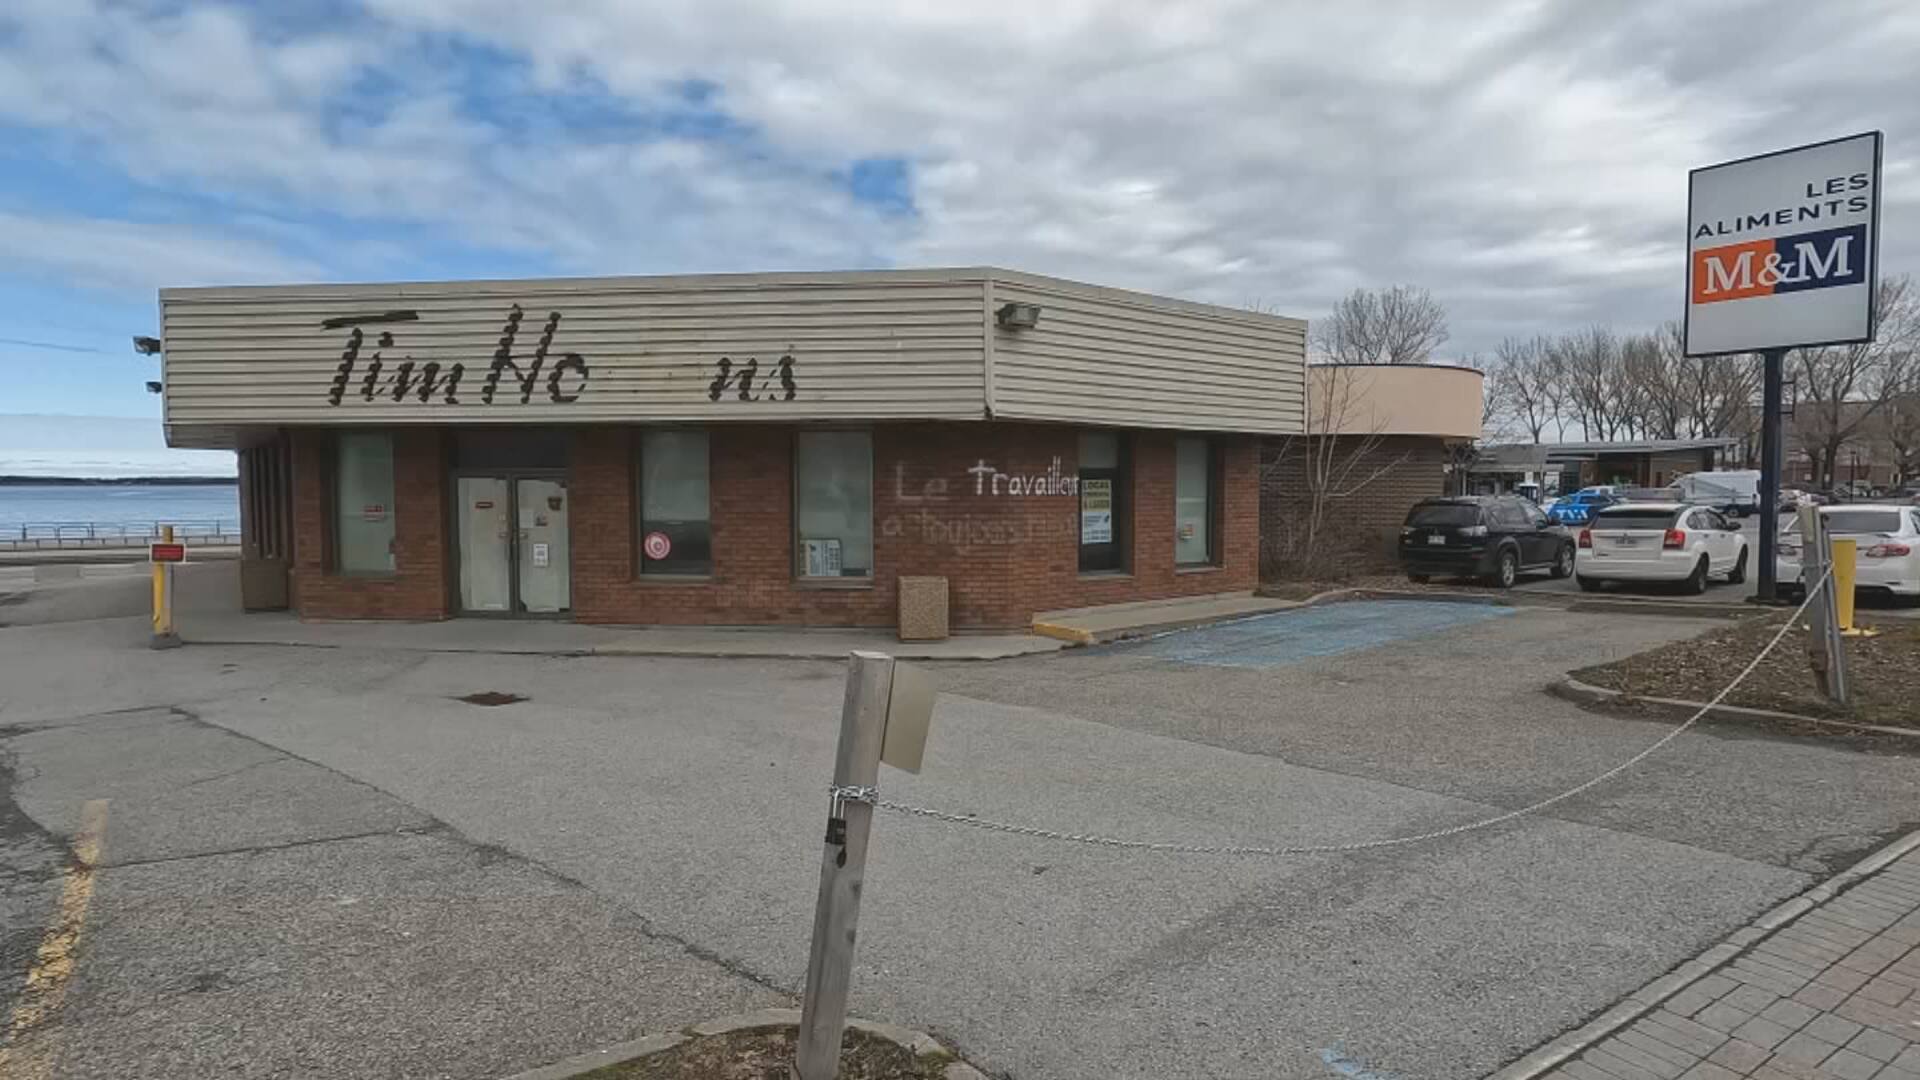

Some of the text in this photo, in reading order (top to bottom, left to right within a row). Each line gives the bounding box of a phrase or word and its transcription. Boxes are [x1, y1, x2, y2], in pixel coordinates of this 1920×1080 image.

[1806, 173, 1869, 198] LES
[1694, 196, 1869, 240] ALIMENTS
[1702, 235, 1854, 295] M&M
[322, 309, 465, 406] Tim
[895, 461, 950, 502] Le
